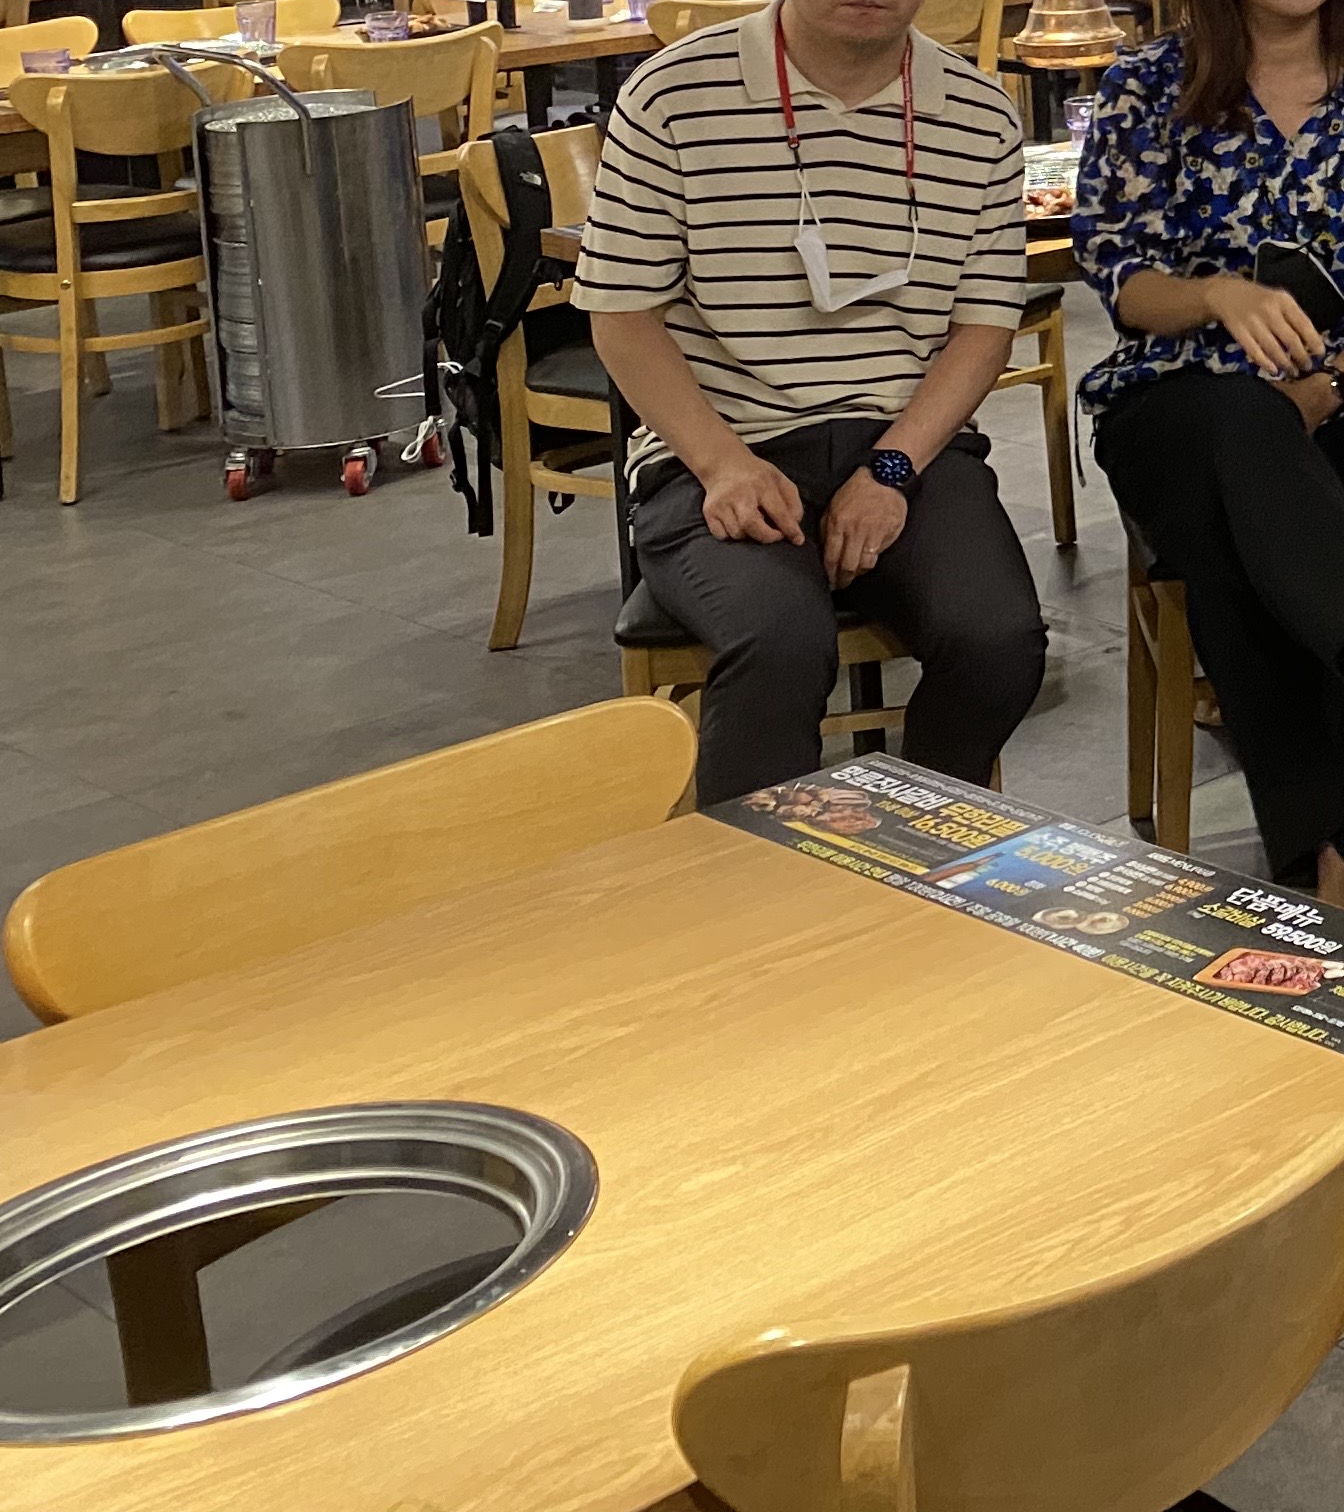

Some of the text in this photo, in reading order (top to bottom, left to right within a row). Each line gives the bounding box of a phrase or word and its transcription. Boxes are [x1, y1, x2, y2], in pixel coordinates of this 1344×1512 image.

[830, 765, 954, 811] 명륜진사갈비
[939, 802, 1031, 837] 무한리필
[907, 814, 998, 849] 16,500원
[1197, 903, 1343, 955] 소갈비살 59,500원
[1226, 887, 1324, 926] 단품메뉴
